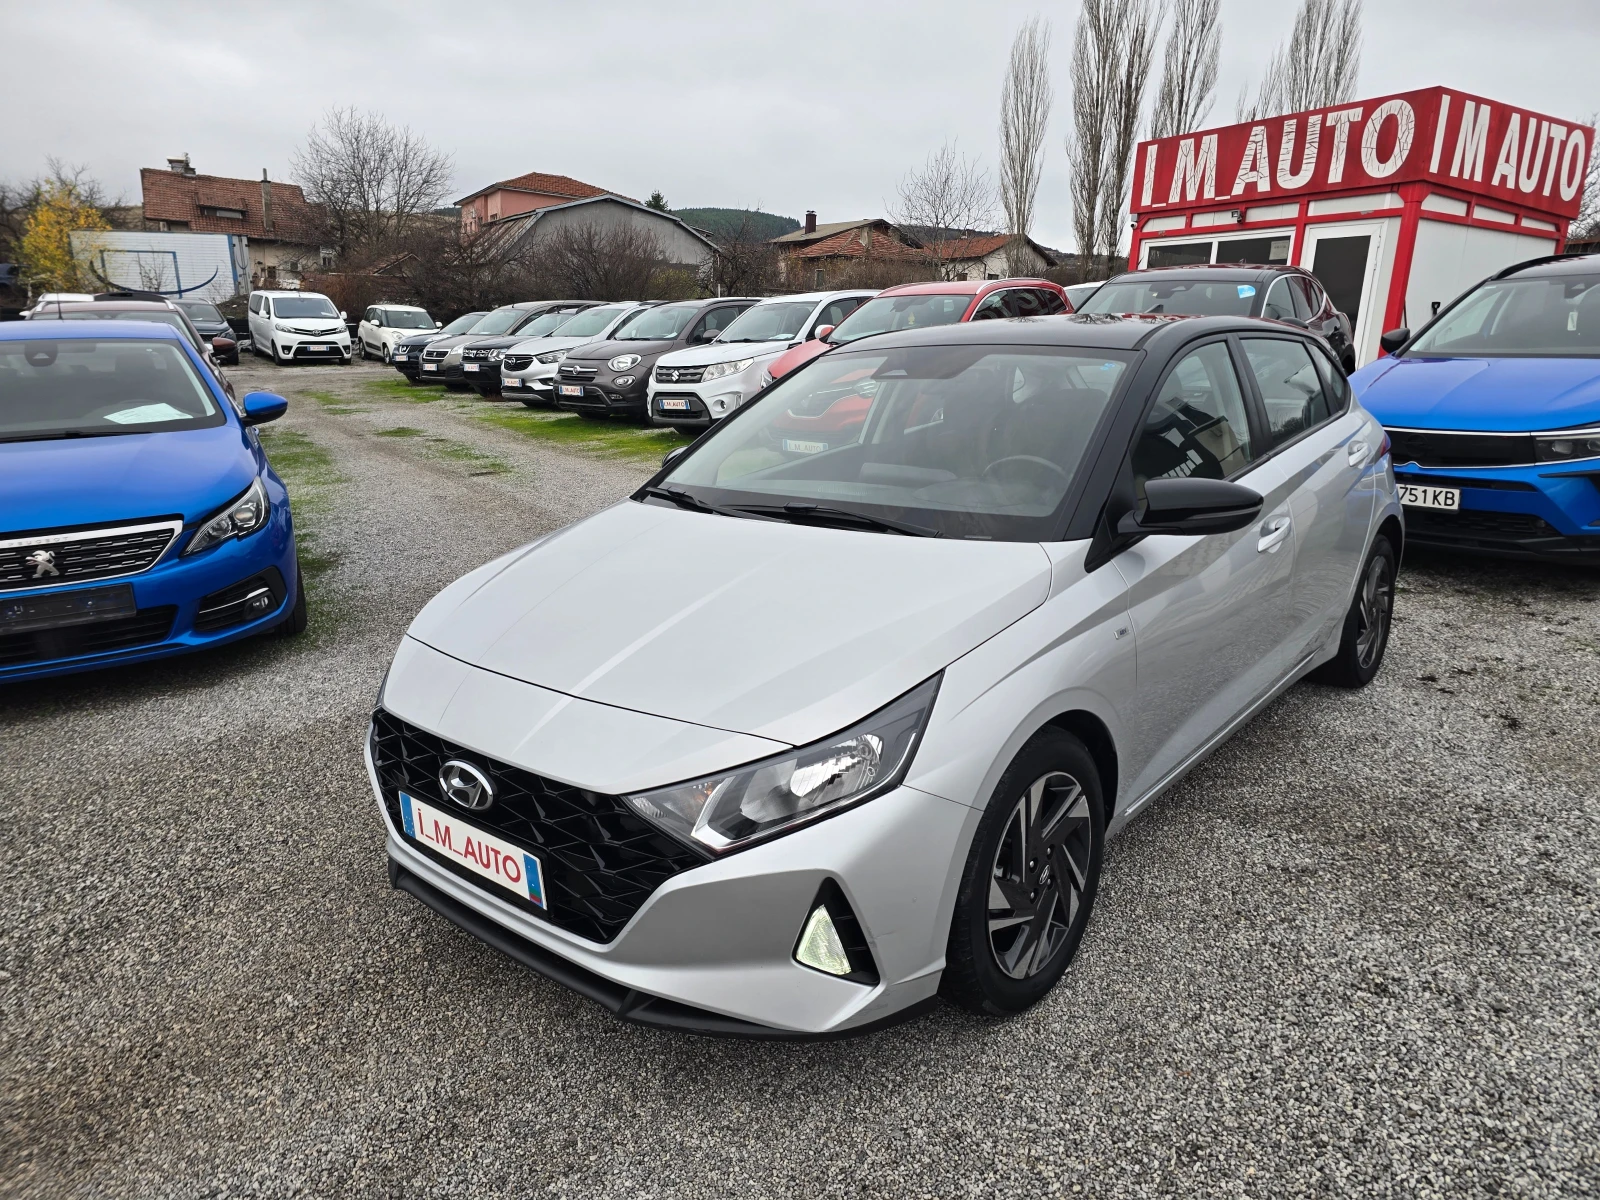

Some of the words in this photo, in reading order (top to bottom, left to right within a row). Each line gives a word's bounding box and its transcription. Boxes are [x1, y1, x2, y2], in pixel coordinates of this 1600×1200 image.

[1429, 94, 1451, 174] I
[1449, 100, 1491, 182] M
[1492, 113, 1586, 201] AUTO
